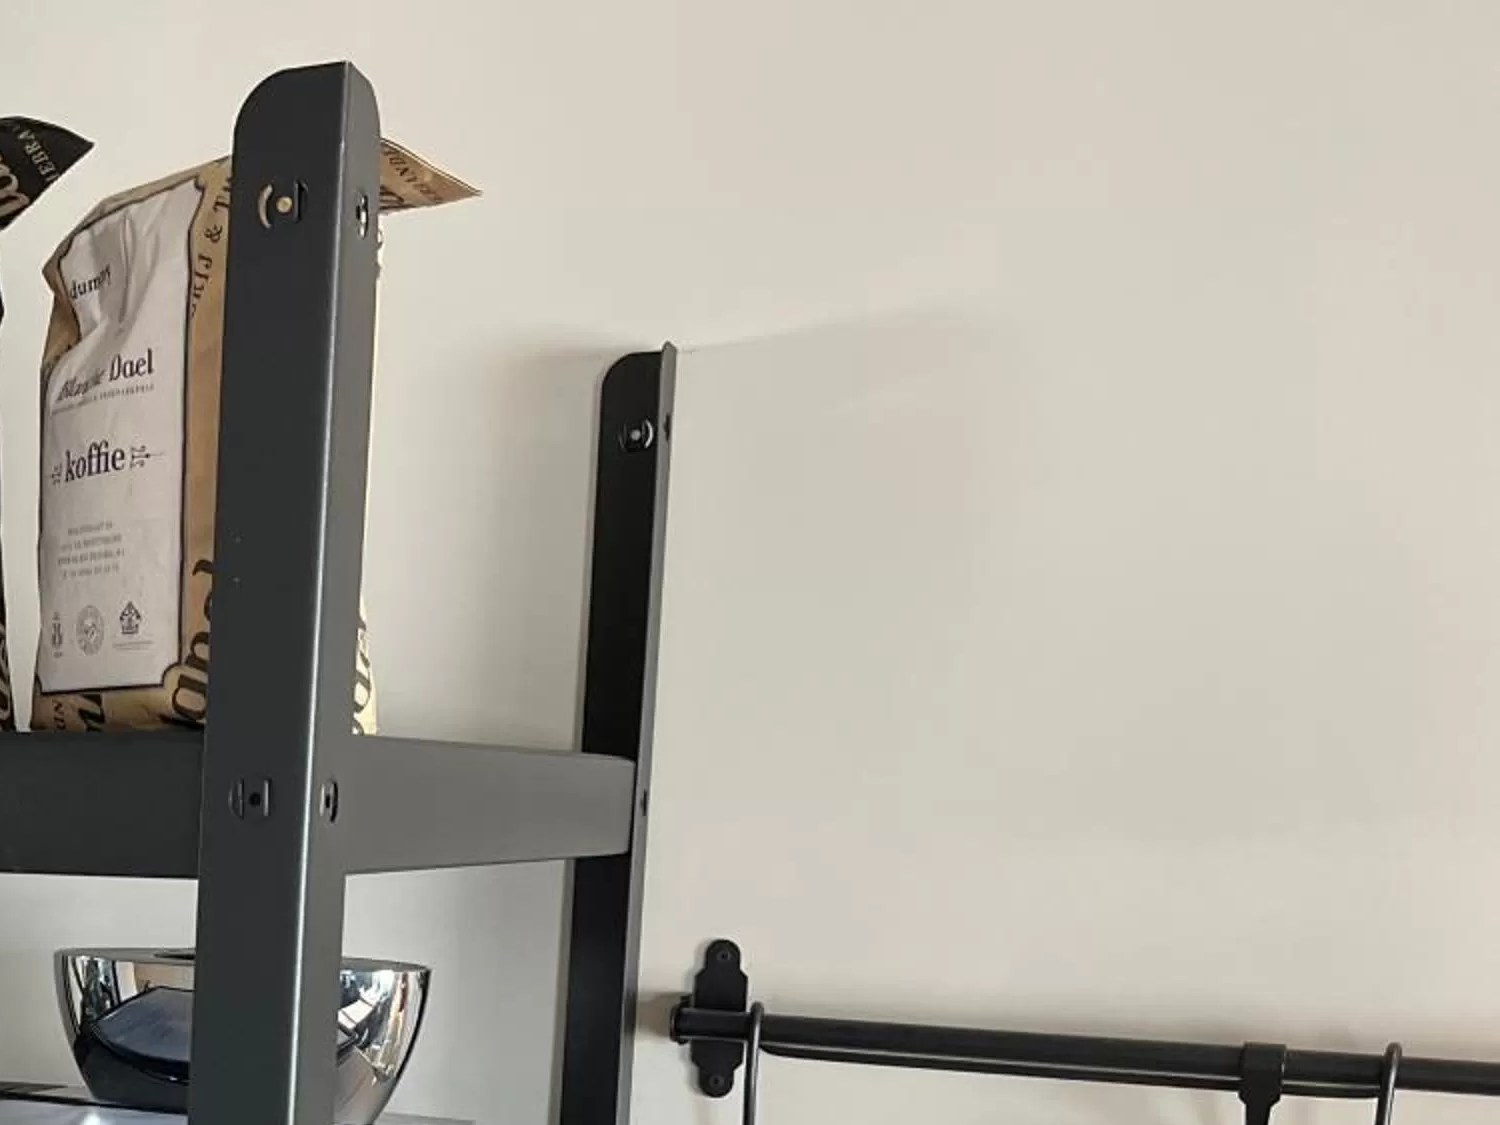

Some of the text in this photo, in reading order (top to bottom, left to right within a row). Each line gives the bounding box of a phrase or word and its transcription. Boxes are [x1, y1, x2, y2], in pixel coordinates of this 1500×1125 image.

[204, 223, 224, 244] &
[108, 347, 155, 383] Dael
[63, 438, 127, 484] koffie
